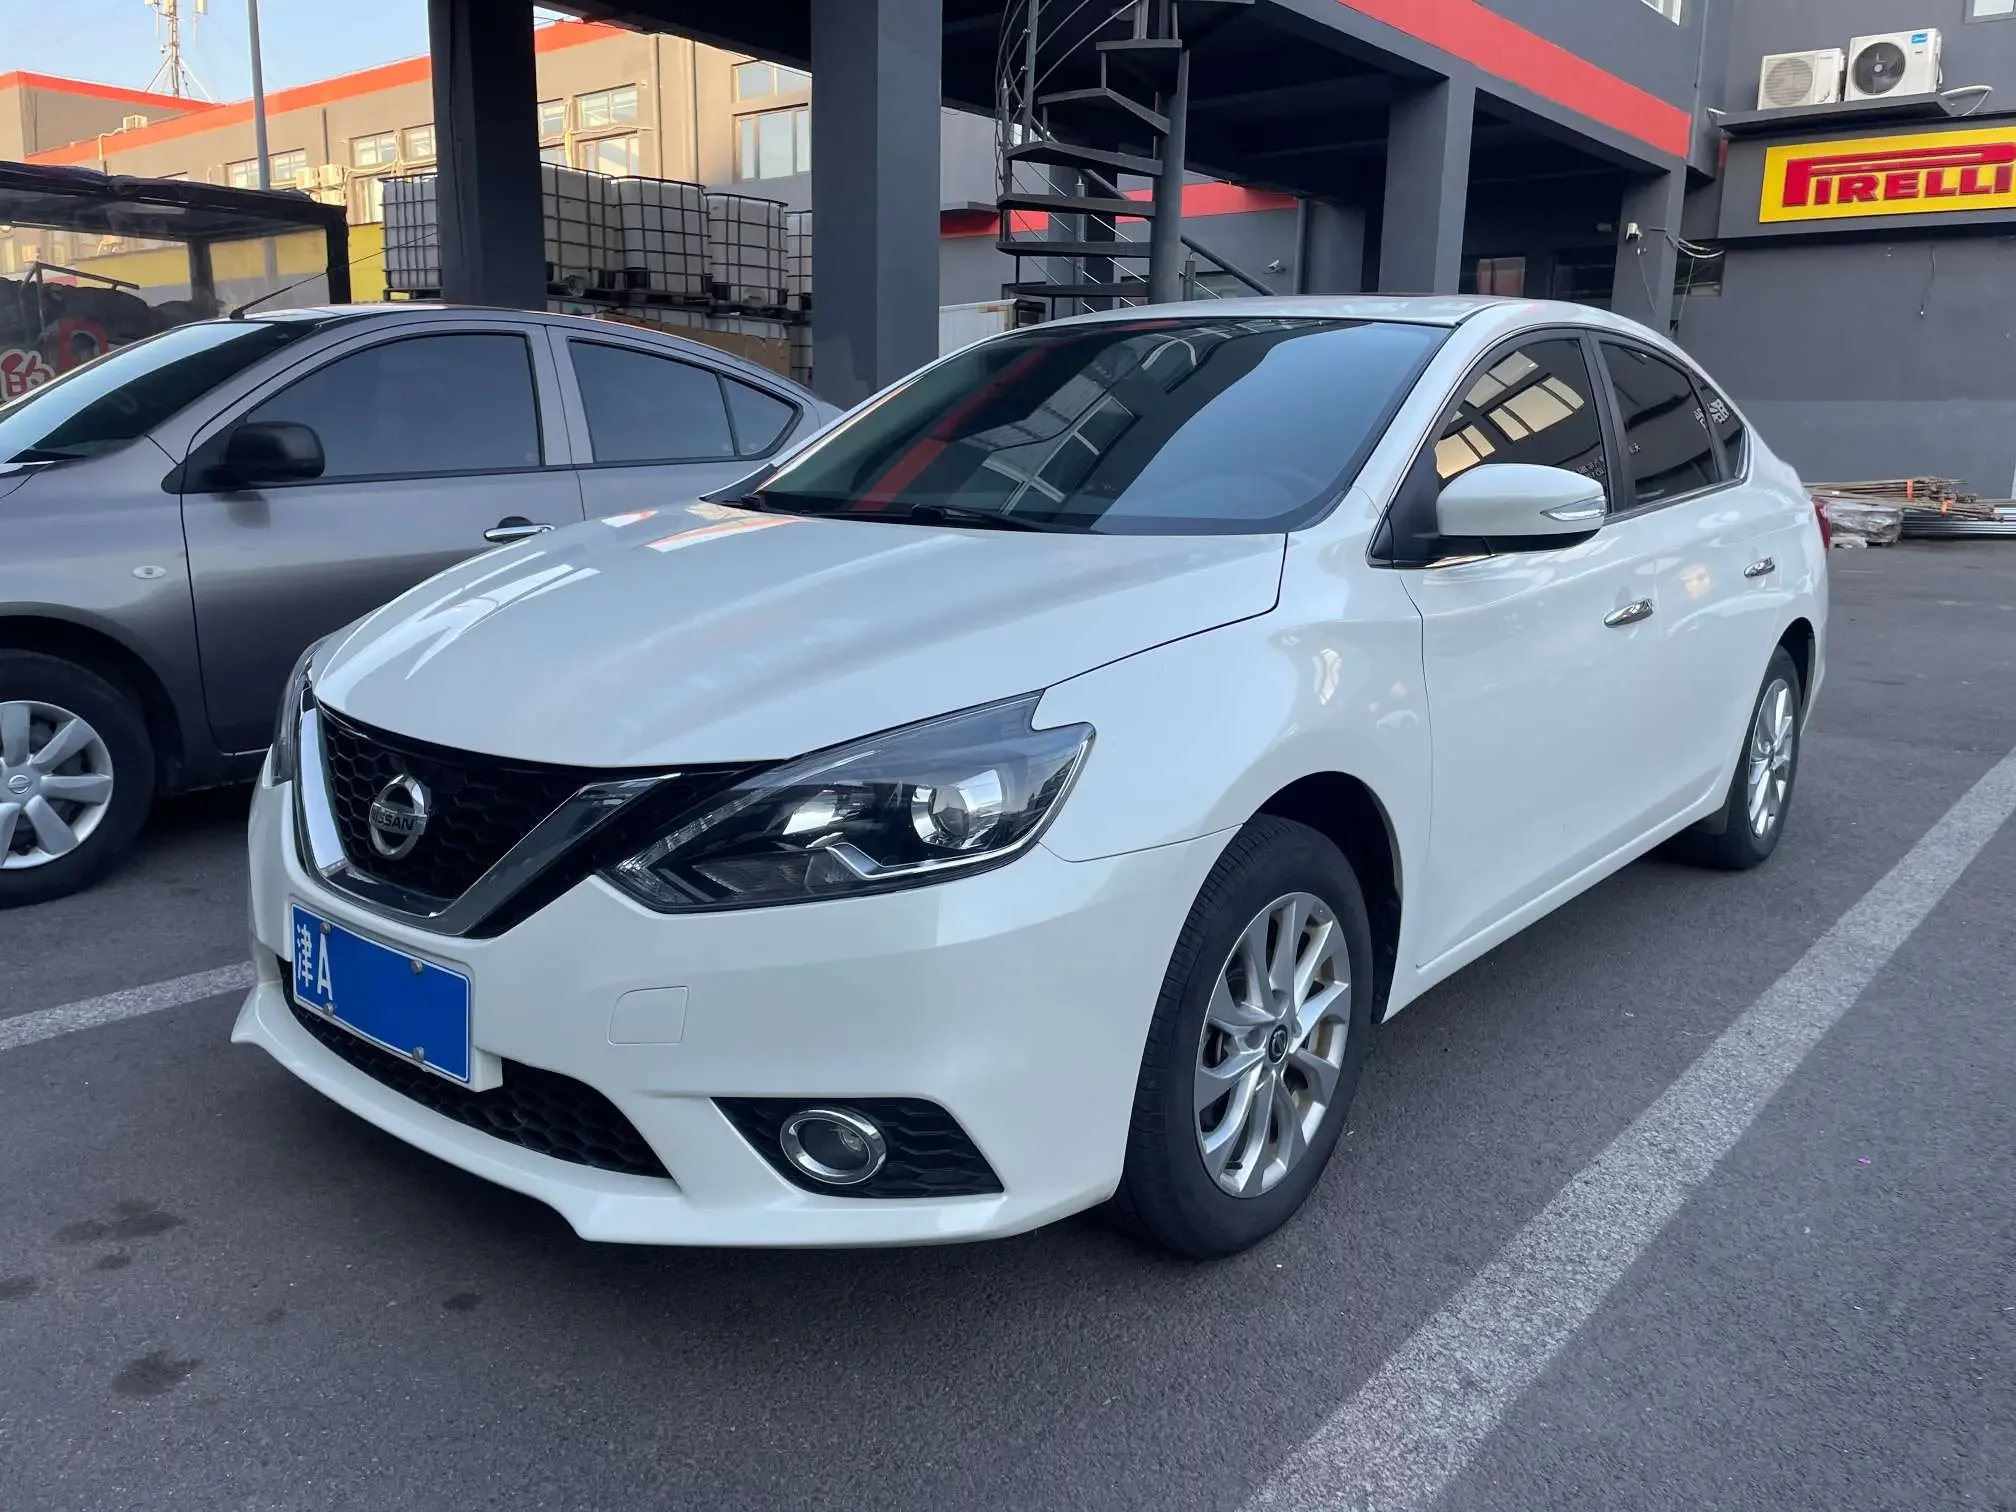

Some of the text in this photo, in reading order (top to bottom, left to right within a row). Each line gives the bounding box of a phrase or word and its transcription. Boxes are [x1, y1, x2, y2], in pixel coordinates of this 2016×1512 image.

[1782, 142, 2016, 207] PIRELLI
[372, 807, 414, 831] NISSAN
[297, 924, 333, 1000] 津A
